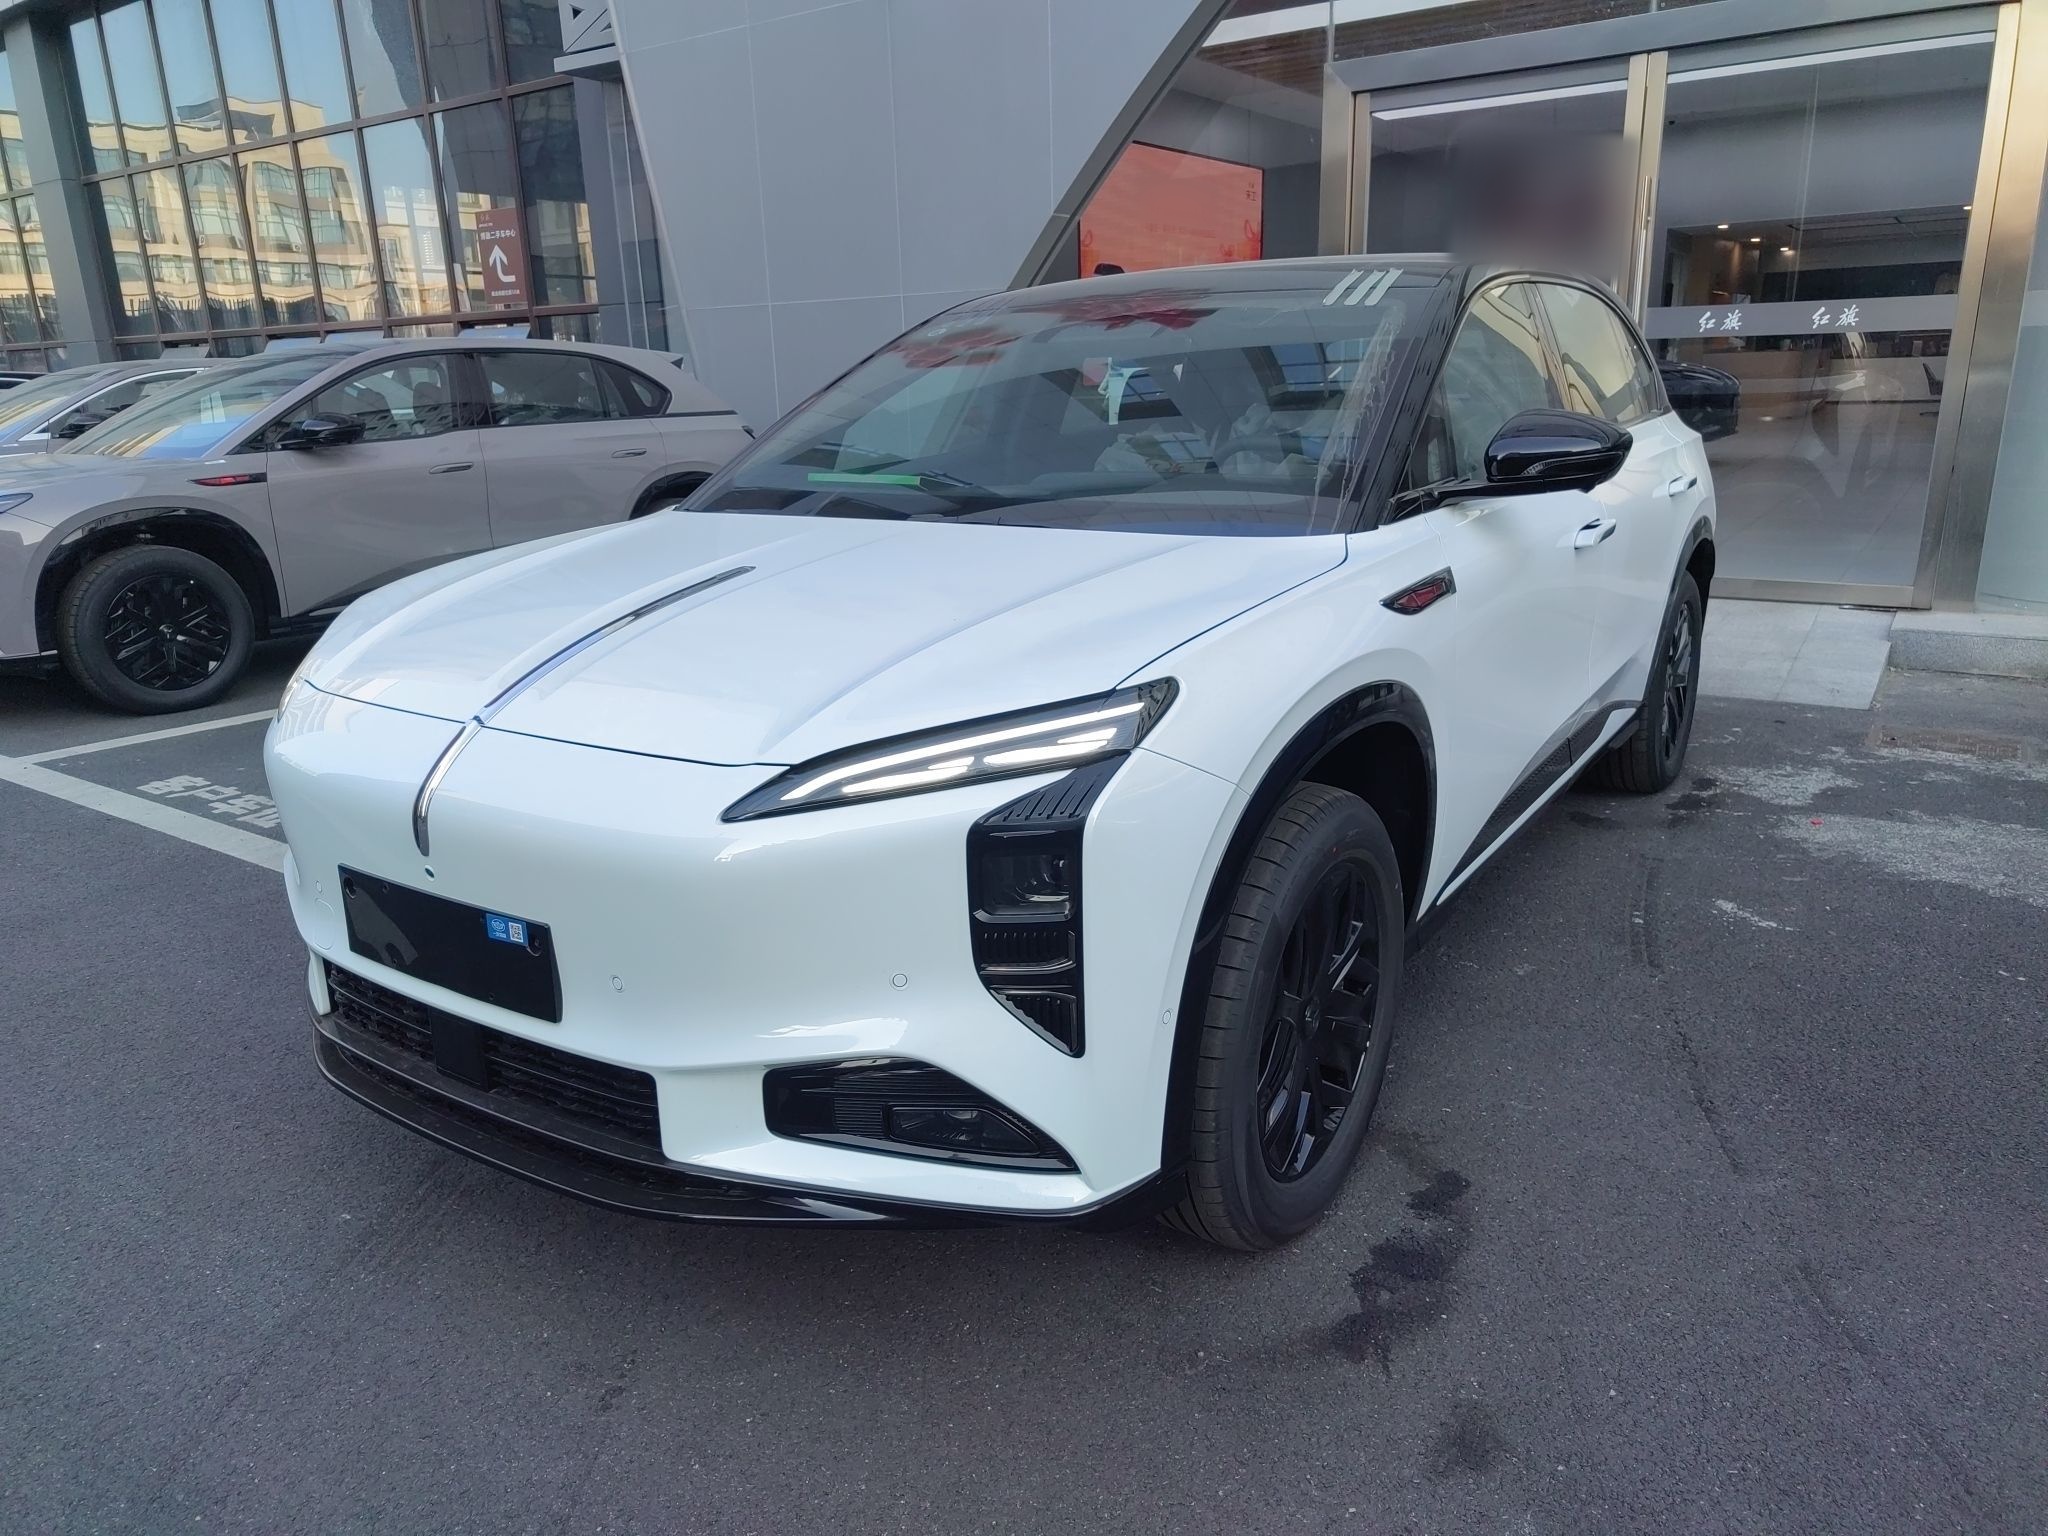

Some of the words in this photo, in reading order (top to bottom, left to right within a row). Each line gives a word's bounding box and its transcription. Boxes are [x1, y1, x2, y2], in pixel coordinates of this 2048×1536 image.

[480, 229, 516, 241] 二手车中心
[1698, 309, 1742, 333] 红旗
[1812, 304, 1860, 329] 红旗
